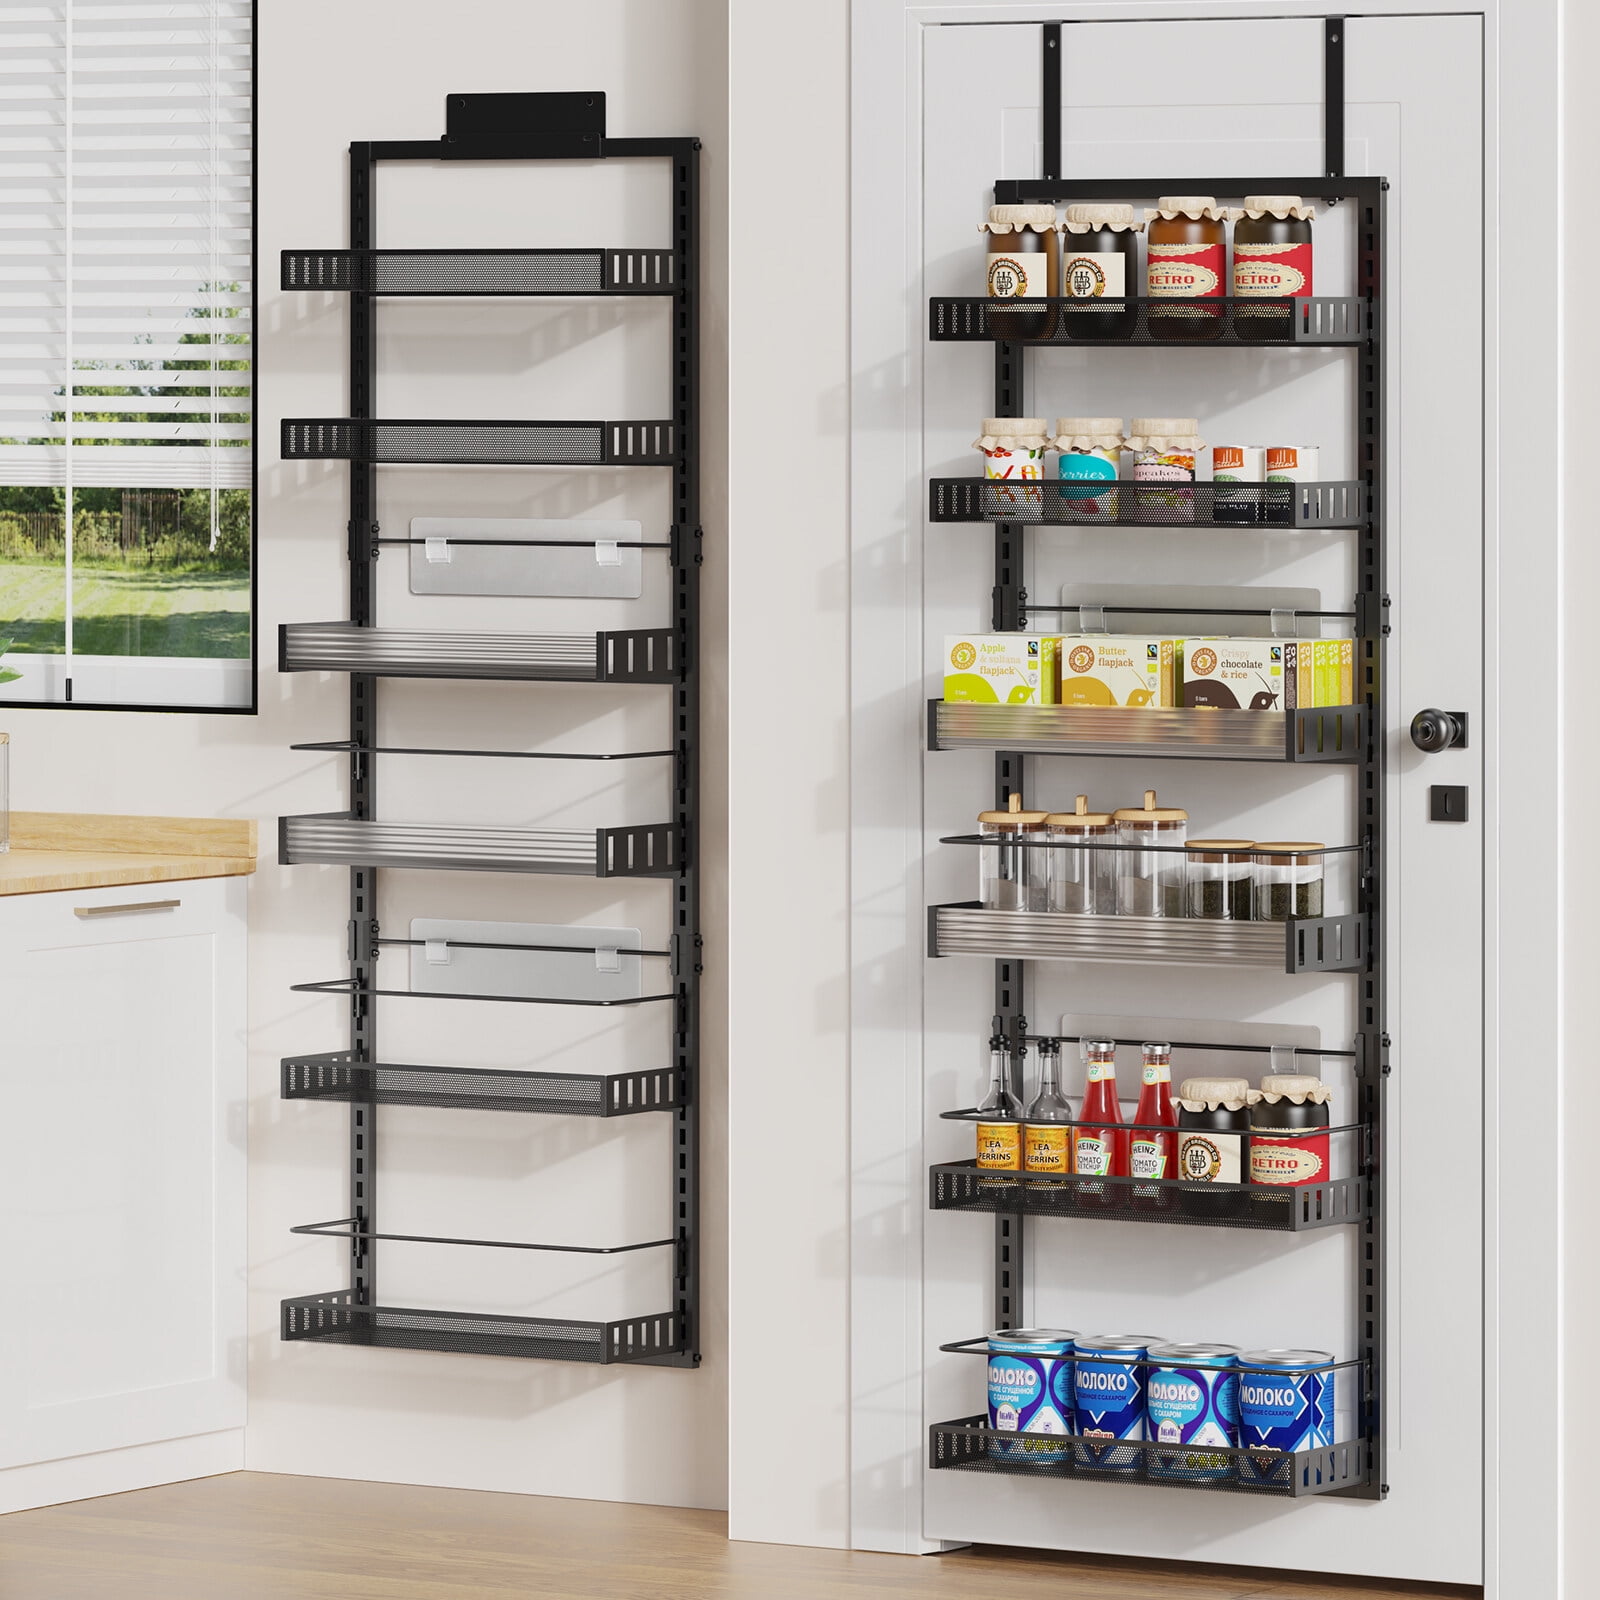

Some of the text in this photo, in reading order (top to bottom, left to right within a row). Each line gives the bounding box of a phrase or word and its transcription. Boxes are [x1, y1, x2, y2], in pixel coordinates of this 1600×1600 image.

[1149, 275, 1195, 284] RETRO
[1235, 275, 1281, 284] RETRO
[980, 643, 1006, 654] Apple
[1098, 646, 1127, 656] Butter
[1221, 648, 1250, 660] Crispy
[989, 655, 1021, 665] sultana
[1098, 658, 1134, 668] flapjack
[1221, 660, 1263, 669] chocolate
[980, 666, 1015, 676] flapjack
[1221, 671, 1248, 679] & rice
[1077, 1142, 1100, 1152] HEINZ
[1133, 1145, 1156, 1155] HEINZ
[1077, 1155, 1101, 1164] TOMATO
[1133, 1158, 1157, 1167] TOMATO
[1252, 1157, 1298, 1168] RETRO
[1077, 1371, 1128, 1391] МОЛОКО
[1148, 1381, 1200, 1402] МОЛОКО
[1241, 1386, 1295, 1406] МОЛОКО
[1164, 1402, 1197, 1410] СГУЩЕННОЕ
